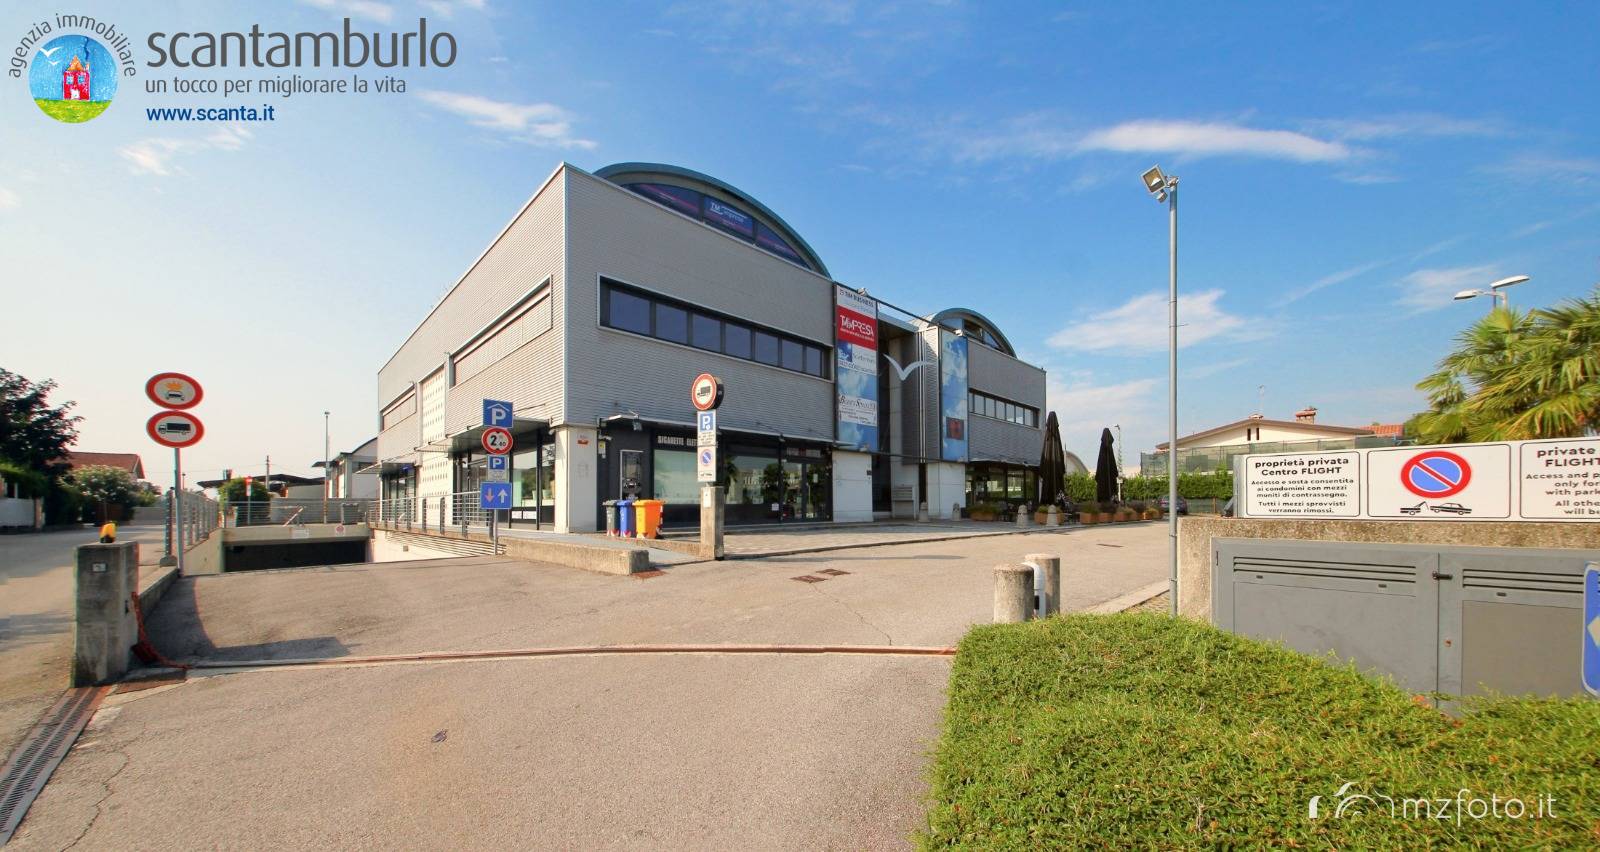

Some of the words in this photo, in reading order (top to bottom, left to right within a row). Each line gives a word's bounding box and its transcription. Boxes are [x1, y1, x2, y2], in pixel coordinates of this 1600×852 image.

[491, 408, 506, 425] P
[702, 415, 711, 429] P
[1537, 446, 1596, 458] private
[492, 458, 502, 469] P
[1255, 458, 1305, 468] proprietà
[1308, 457, 1349, 467] privata
[1545, 457, 1600, 467] FLIGHT
[1301, 467, 1342, 475] FLIGHT
[1554, 480, 1579, 488] only
